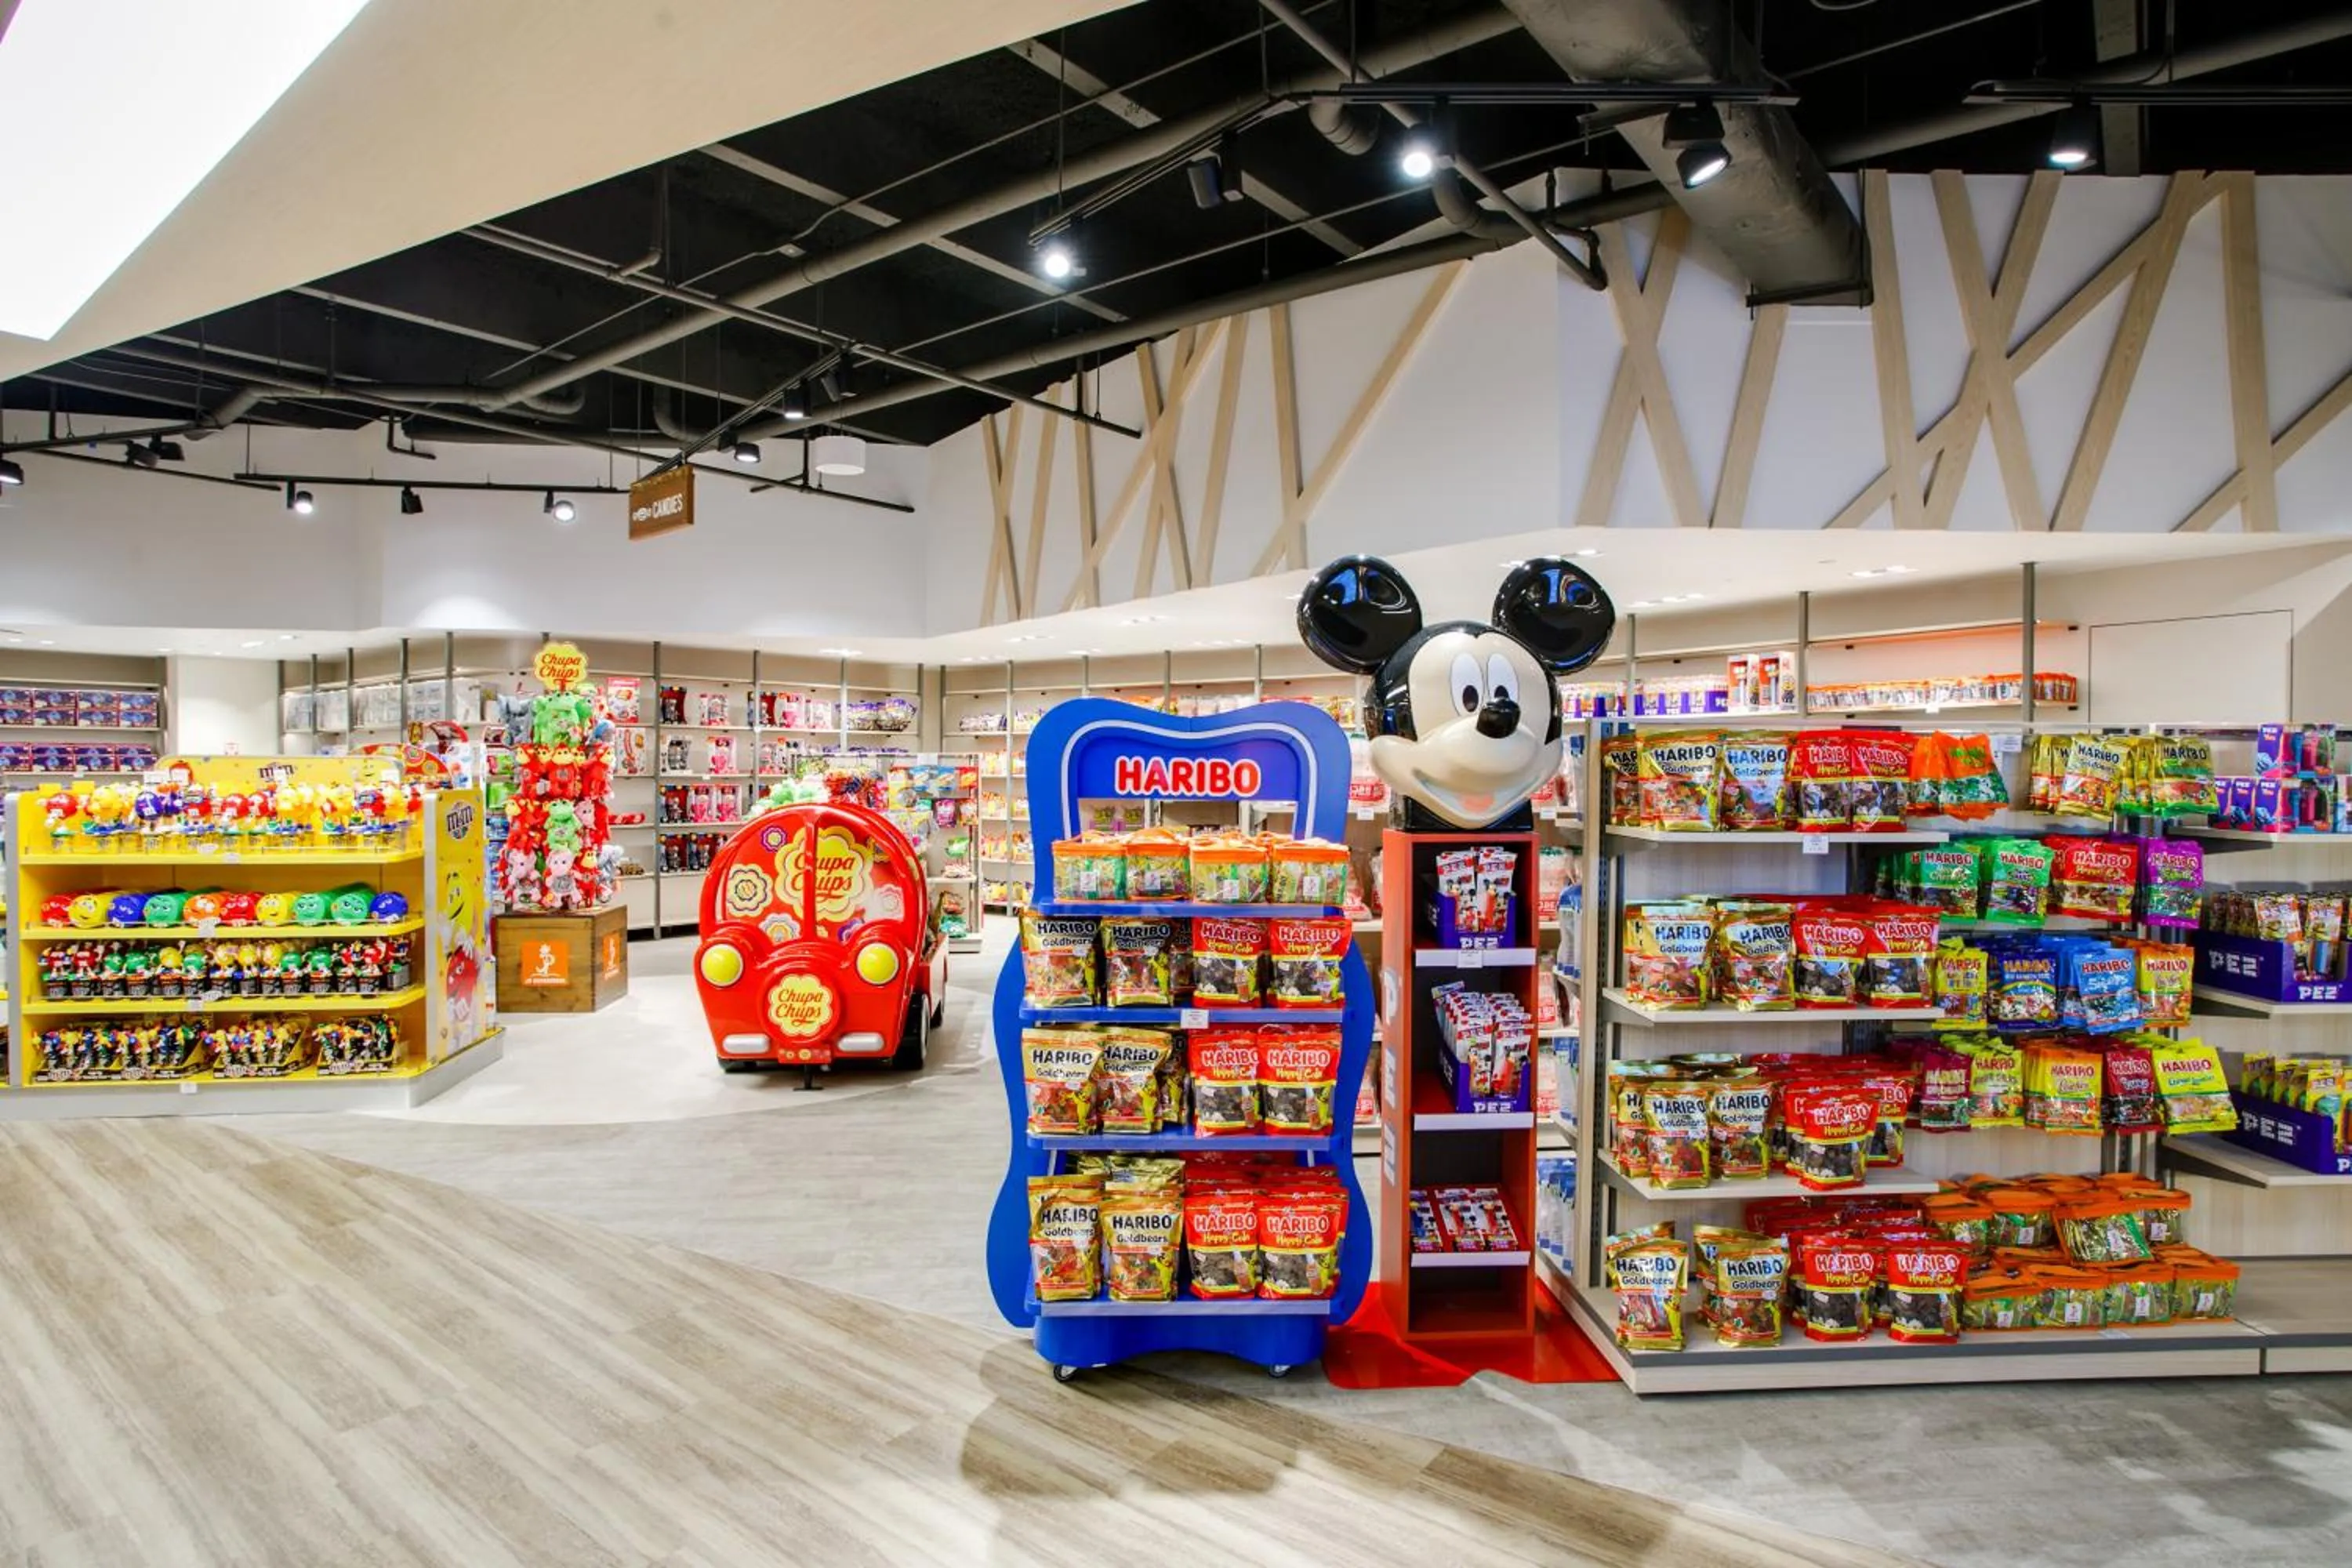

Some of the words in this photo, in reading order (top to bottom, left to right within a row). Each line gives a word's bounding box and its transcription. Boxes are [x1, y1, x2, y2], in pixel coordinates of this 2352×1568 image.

[541, 653, 582, 668] Chupa
[539, 666, 579, 681] Chups
[1654, 746, 1716, 761] HARIBO
[1727, 748, 1787, 764] HARIBO
[2078, 745, 2119, 764] HARIBO
[2163, 746, 2207, 760] HARIBO
[1115, 756, 1261, 797] HARIBO
[794, 852, 855, 876] Cupa
[1926, 853, 1973, 865] HARIBO
[791, 872, 853, 895] Cups
[1037, 921, 1096, 935] HARIBO
[1112, 924, 1171, 938] HARIBO
[1201, 921, 1261, 943] HARIBO
[1279, 925, 1341, 945] HARIBO
[1655, 926, 1711, 940] HARIBO
[1802, 924, 1865, 946] HARIBO
[1875, 922, 1934, 938] HARIBO
[1459, 937, 1499, 950] PEZ
[2209, 949, 2259, 978] PEZ
[778, 989, 823, 1006] Chupa
[2298, 985, 2338, 1000] PEZ
[776, 1004, 822, 1021] Chups
[1032, 1049, 1094, 1066] HARIBO
[1102, 1045, 1160, 1061] HARIBO
[1267, 1049, 1331, 1067] HARIBO
[2161, 1059, 2212, 1073] HARIBO
[1473, 1101, 1512, 1112] PEZ
[1653, 1099, 1706, 1115] HARIBO
[1715, 1094, 1771, 1111] HARIBO
[2242, 1110, 2294, 1145] PEZ
[1041, 1208, 1098, 1224] HARIBO
[1112, 1215, 1173, 1230] HARIBO
[1194, 1213, 1258, 1232] HARIBO
[1266, 1215, 1330, 1233] HARIBO
[1727, 1259, 1783, 1276] HARIBO
[1815, 1254, 1875, 1272] HARIBO
